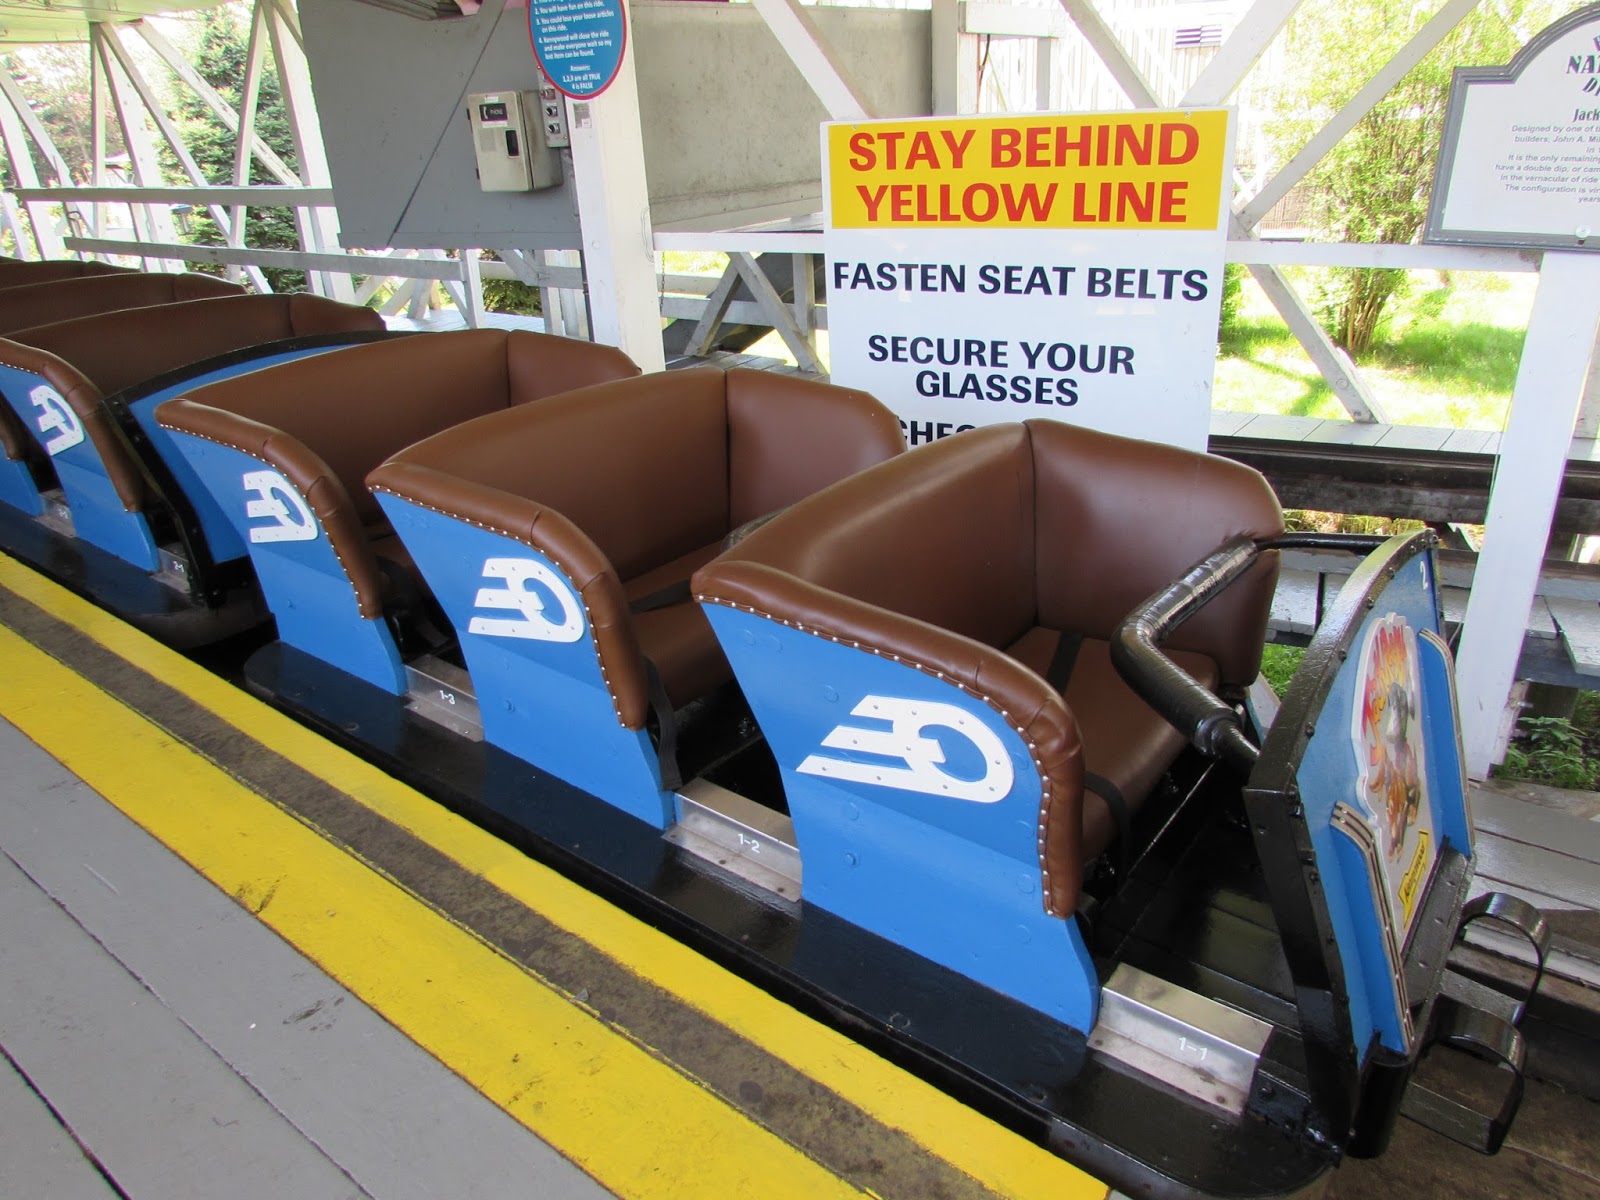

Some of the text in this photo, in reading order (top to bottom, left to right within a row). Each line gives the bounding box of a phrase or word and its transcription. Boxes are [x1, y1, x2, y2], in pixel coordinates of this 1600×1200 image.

[550, 15, 562, 24] could
[1572, 109, 1600, 123] Jack
[1512, 125, 1551, 133] Designed
[849, 122, 1200, 172] STAY BEHIND
[1521, 185, 1576, 193] configuration
[856, 181, 1189, 223] YELLOW LINE
[833, 262, 1208, 301] FASTEN SEAT BELTS
[868, 334, 1135, 376] SECURE YOUR
[915, 370, 1078, 407] GLASSES
[440, 690, 455, 704] 1-3
[738, 833, 760, 854] 1-2
[1178, 1036, 1207, 1060] 1-1
